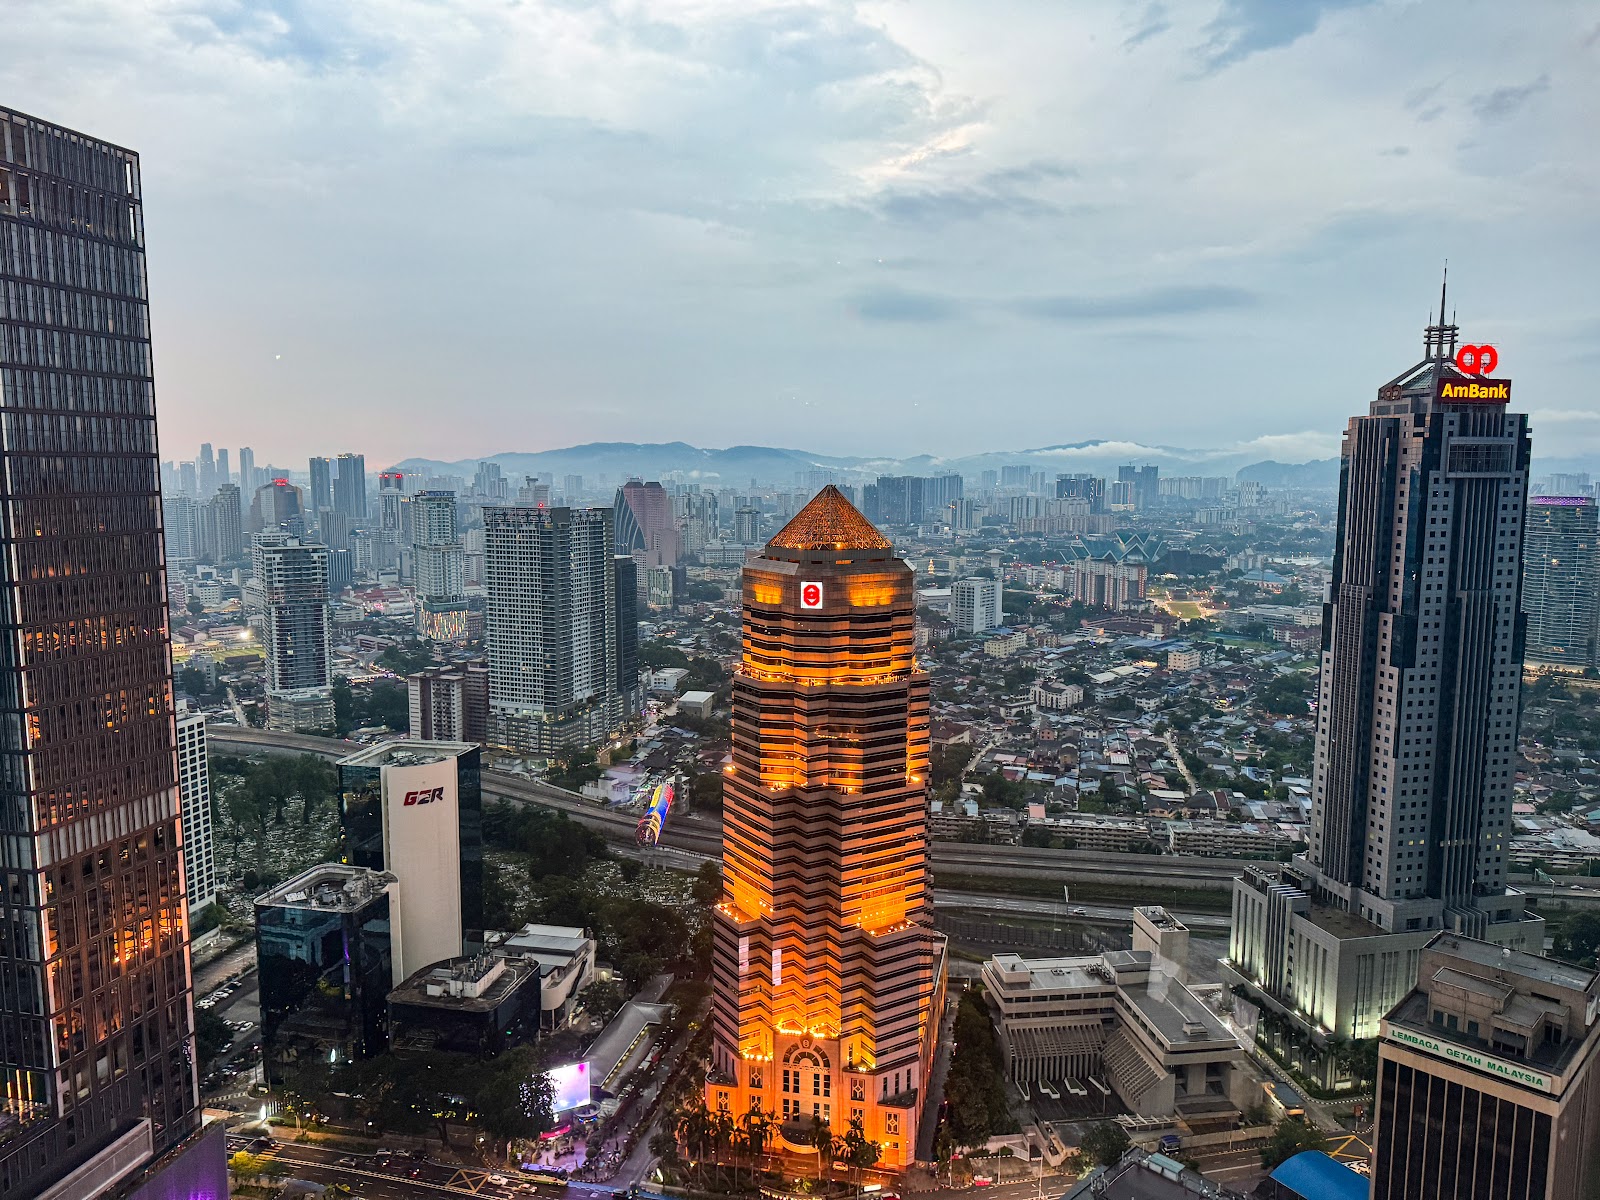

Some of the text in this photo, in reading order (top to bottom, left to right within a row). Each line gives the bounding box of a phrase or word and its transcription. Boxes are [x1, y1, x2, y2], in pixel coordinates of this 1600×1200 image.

[1441, 383, 1508, 398] AmBank
[1392, 1030, 1543, 1086] LEMBAGA GETAH MALAYSIA
